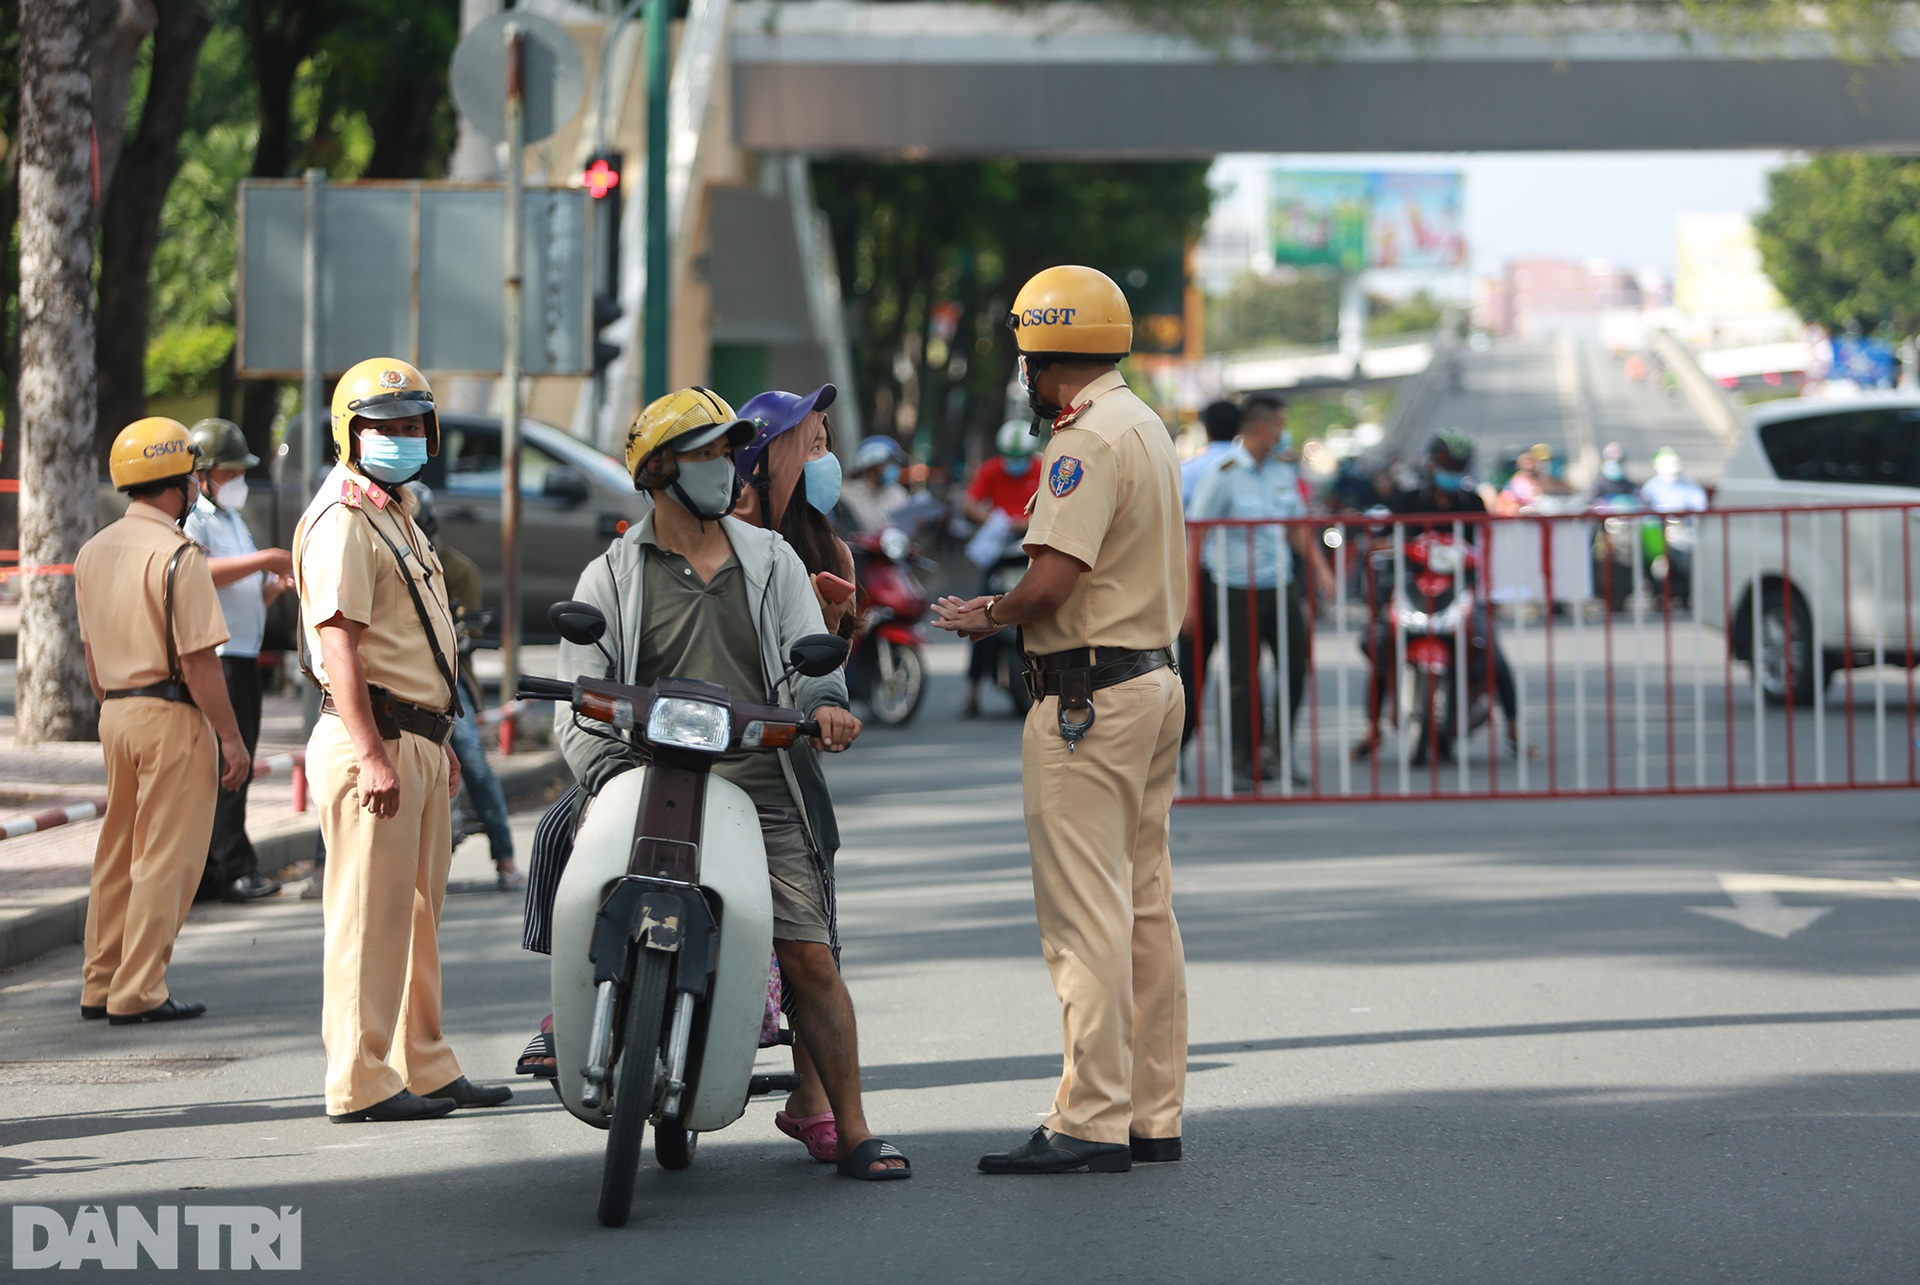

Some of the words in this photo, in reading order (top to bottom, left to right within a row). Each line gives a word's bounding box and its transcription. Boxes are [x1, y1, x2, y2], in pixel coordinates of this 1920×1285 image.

[1021, 308, 1076, 327] CSGT
[143, 440, 185, 459] CSGT
[1051, 474, 1076, 487] CSGT
